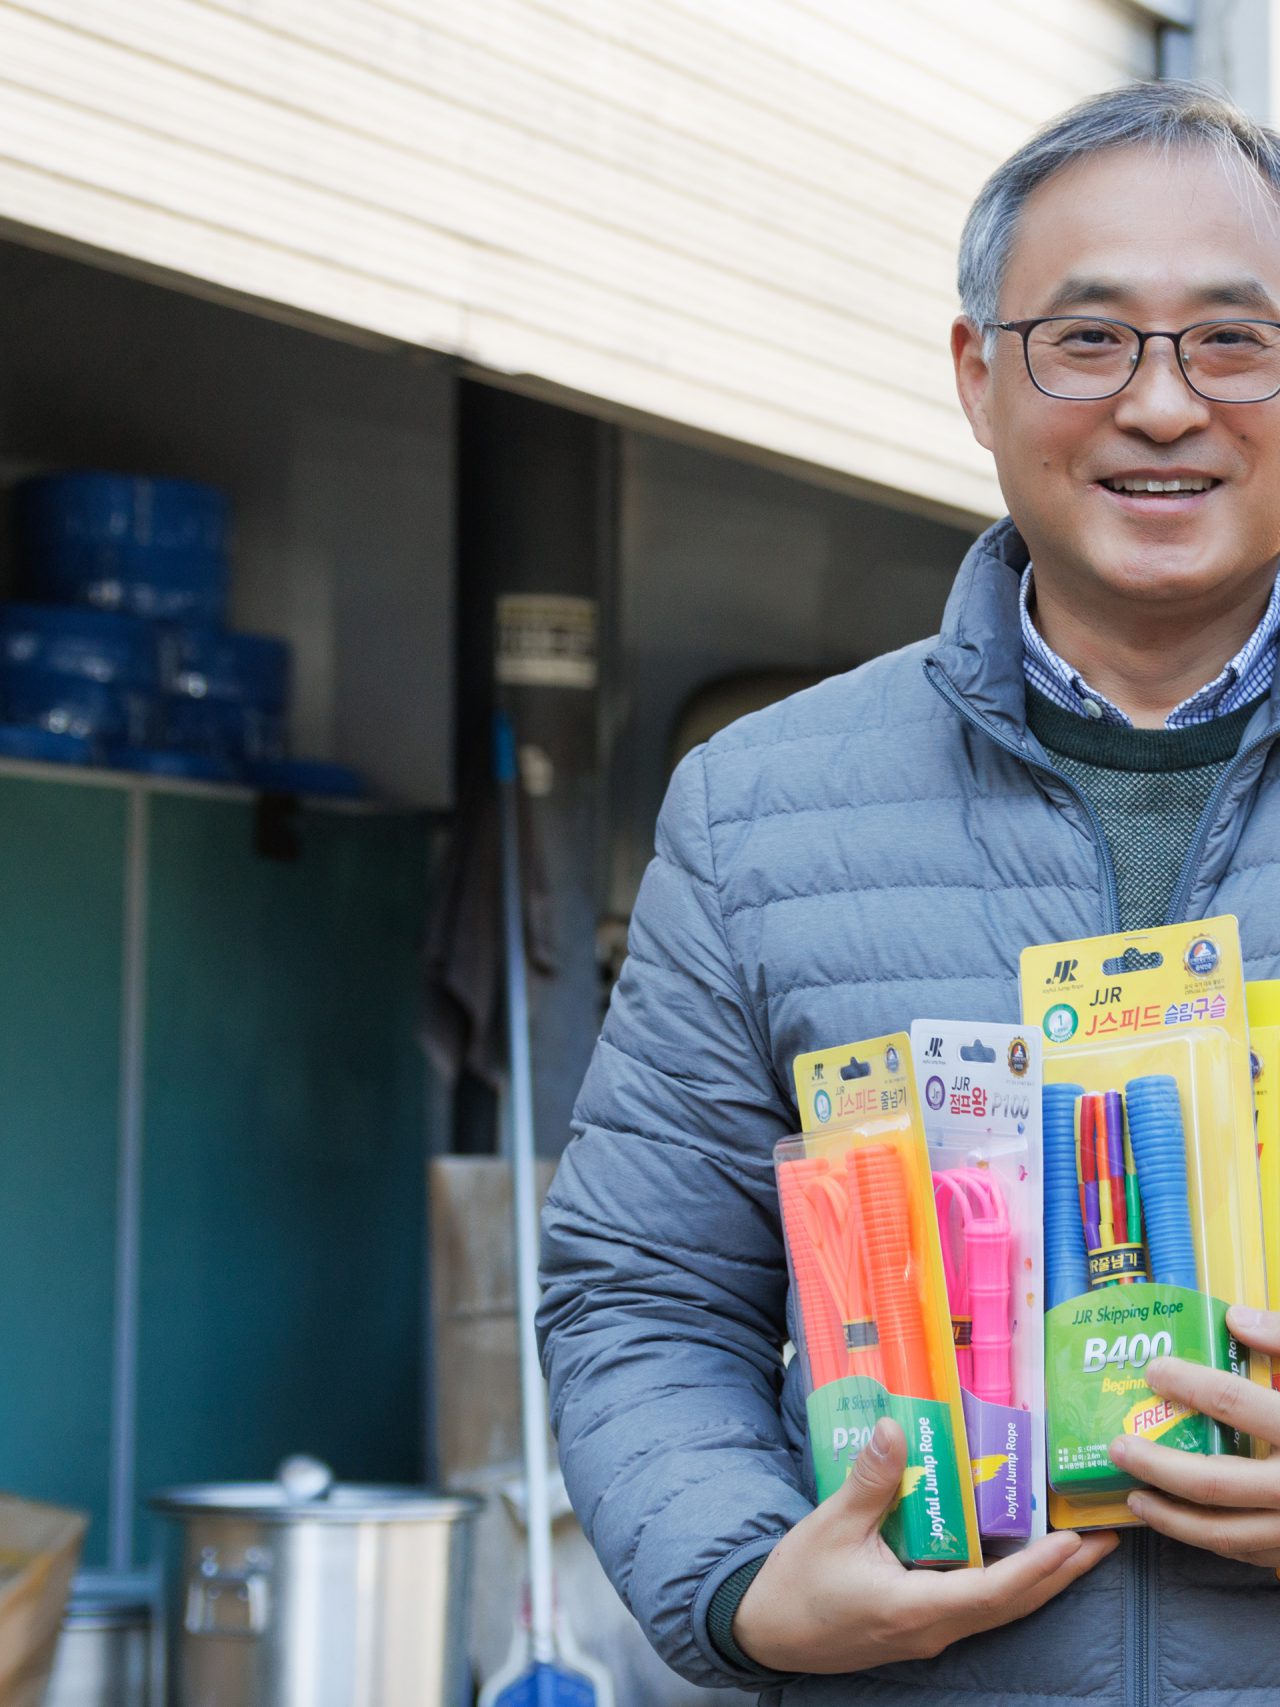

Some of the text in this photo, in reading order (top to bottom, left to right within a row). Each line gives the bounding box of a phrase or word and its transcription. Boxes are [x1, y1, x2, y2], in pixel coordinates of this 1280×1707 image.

[1089, 986, 1122, 1007] JJR
[1057, 1014, 1063, 1026] 1
[1085, 993, 1227, 1036] J스피드 슬림구슬
[952, 1076, 970, 1091] JJR
[837, 1086, 907, 1117] J스피드 줄넘기
[950, 1087, 1030, 1120] 점프왕 P100
[1089, 1252, 1137, 1273] R줄넘기
[1072, 1301, 1184, 1326] JJR Skipping Rope
[1082, 1330, 1173, 1373] B400
[1101, 1376, 1148, 1396] Beginn
[1133, 1399, 1175, 1434] FREE
[833, 1424, 874, 1461] P30
[918, 1417, 946, 1541] Joyful Jump Rope
[1006, 1422, 1020, 1521] Joyful Jump Rope
